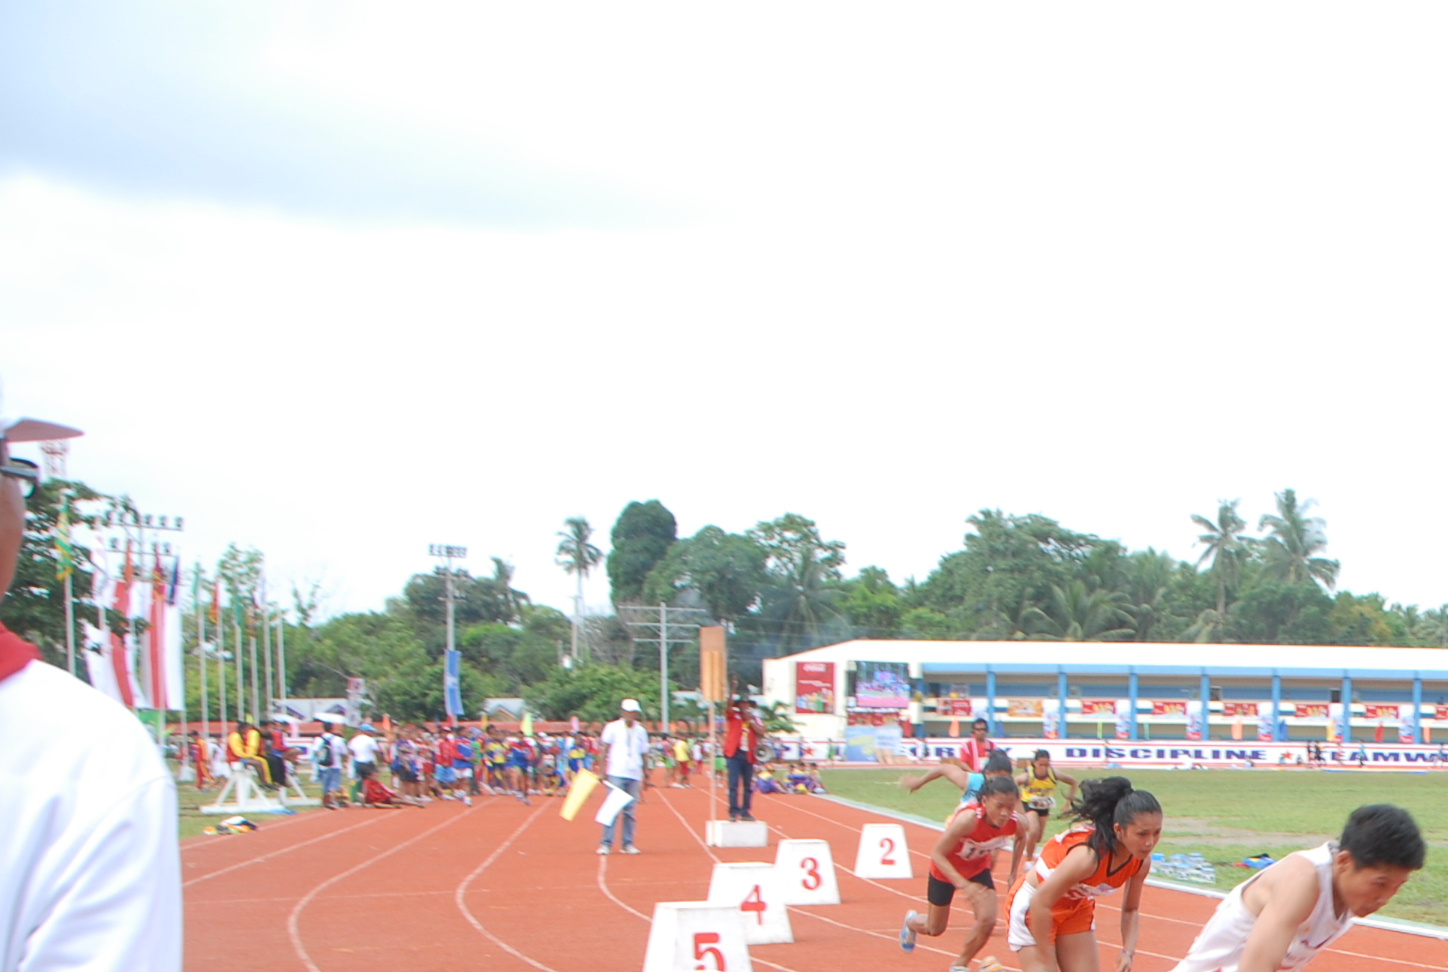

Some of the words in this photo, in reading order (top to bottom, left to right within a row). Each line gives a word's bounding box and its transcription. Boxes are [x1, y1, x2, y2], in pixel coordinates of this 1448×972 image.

[1065, 747, 1267, 760] DISCIPLINE
[880, 838, 896, 865] 2
[800, 857, 822, 890] 3
[739, 884, 767, 925] 4
[693, 932, 727, 972] 5
